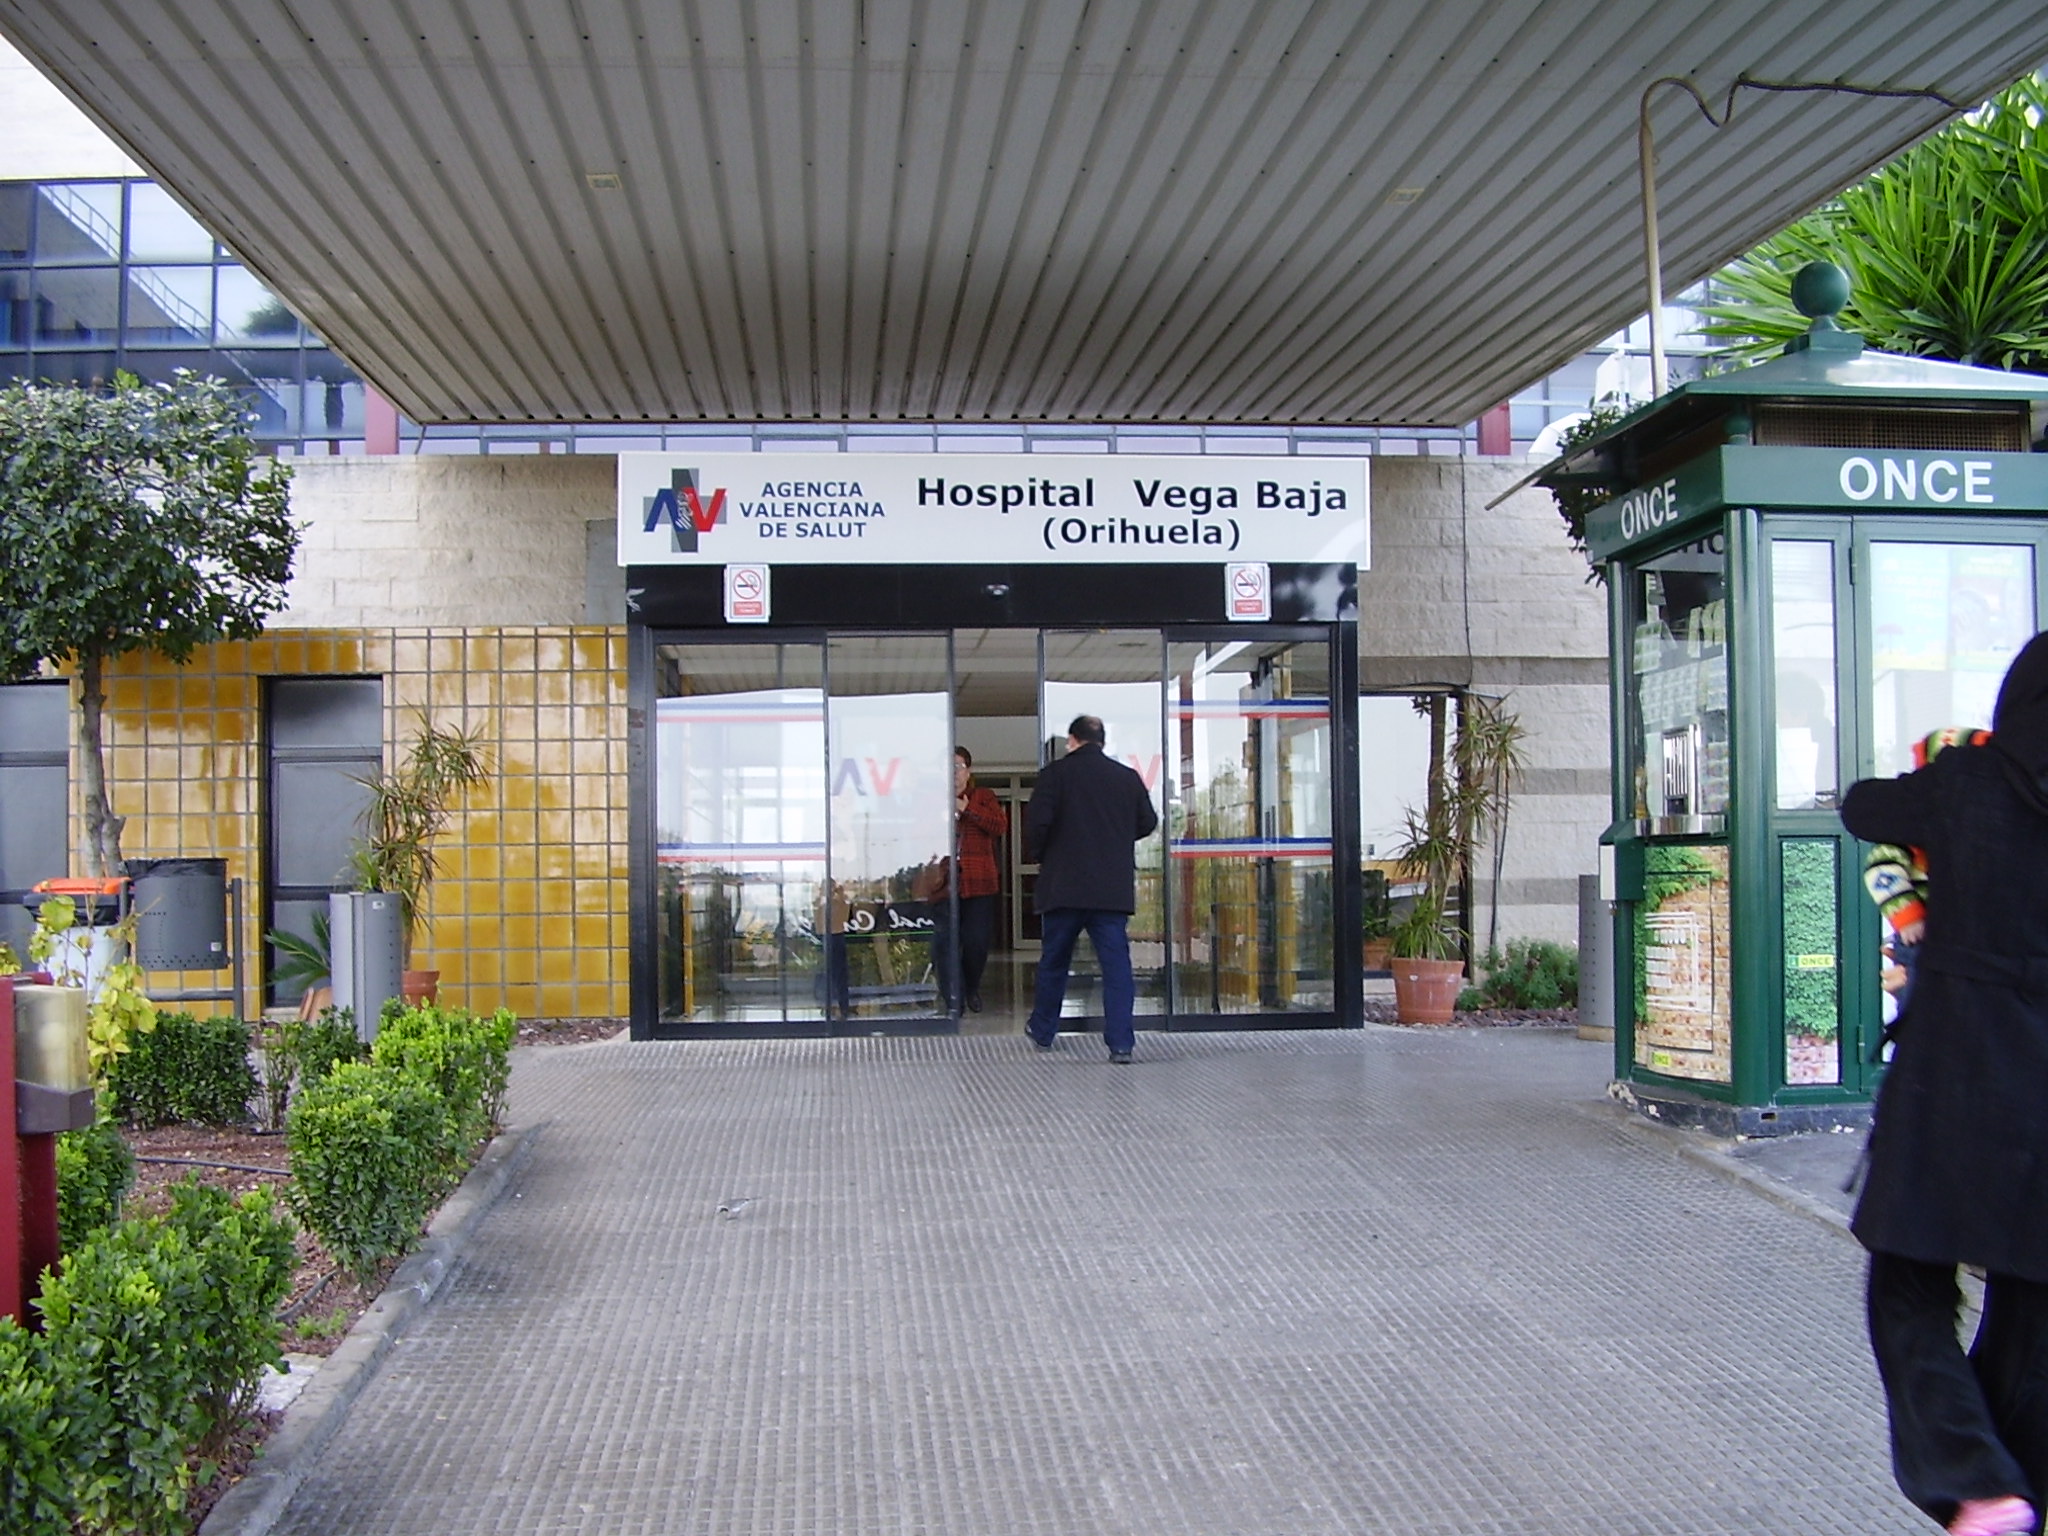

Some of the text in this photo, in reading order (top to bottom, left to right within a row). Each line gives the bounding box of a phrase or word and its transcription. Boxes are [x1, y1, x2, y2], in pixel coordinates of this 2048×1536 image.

[761, 481, 863, 498] AGENCIA
[1840, 457, 1994, 503] ONCE
[918, 477, 1346, 517] Hospital Vega Baja
[1621, 478, 1678, 539] ONCE
[739, 502, 885, 518] VALENCIANA
[759, 522, 867, 538] DE SALUT
[1043, 517, 1240, 551] (Orihuela)
[1800, 956, 1832, 966] ONCE
